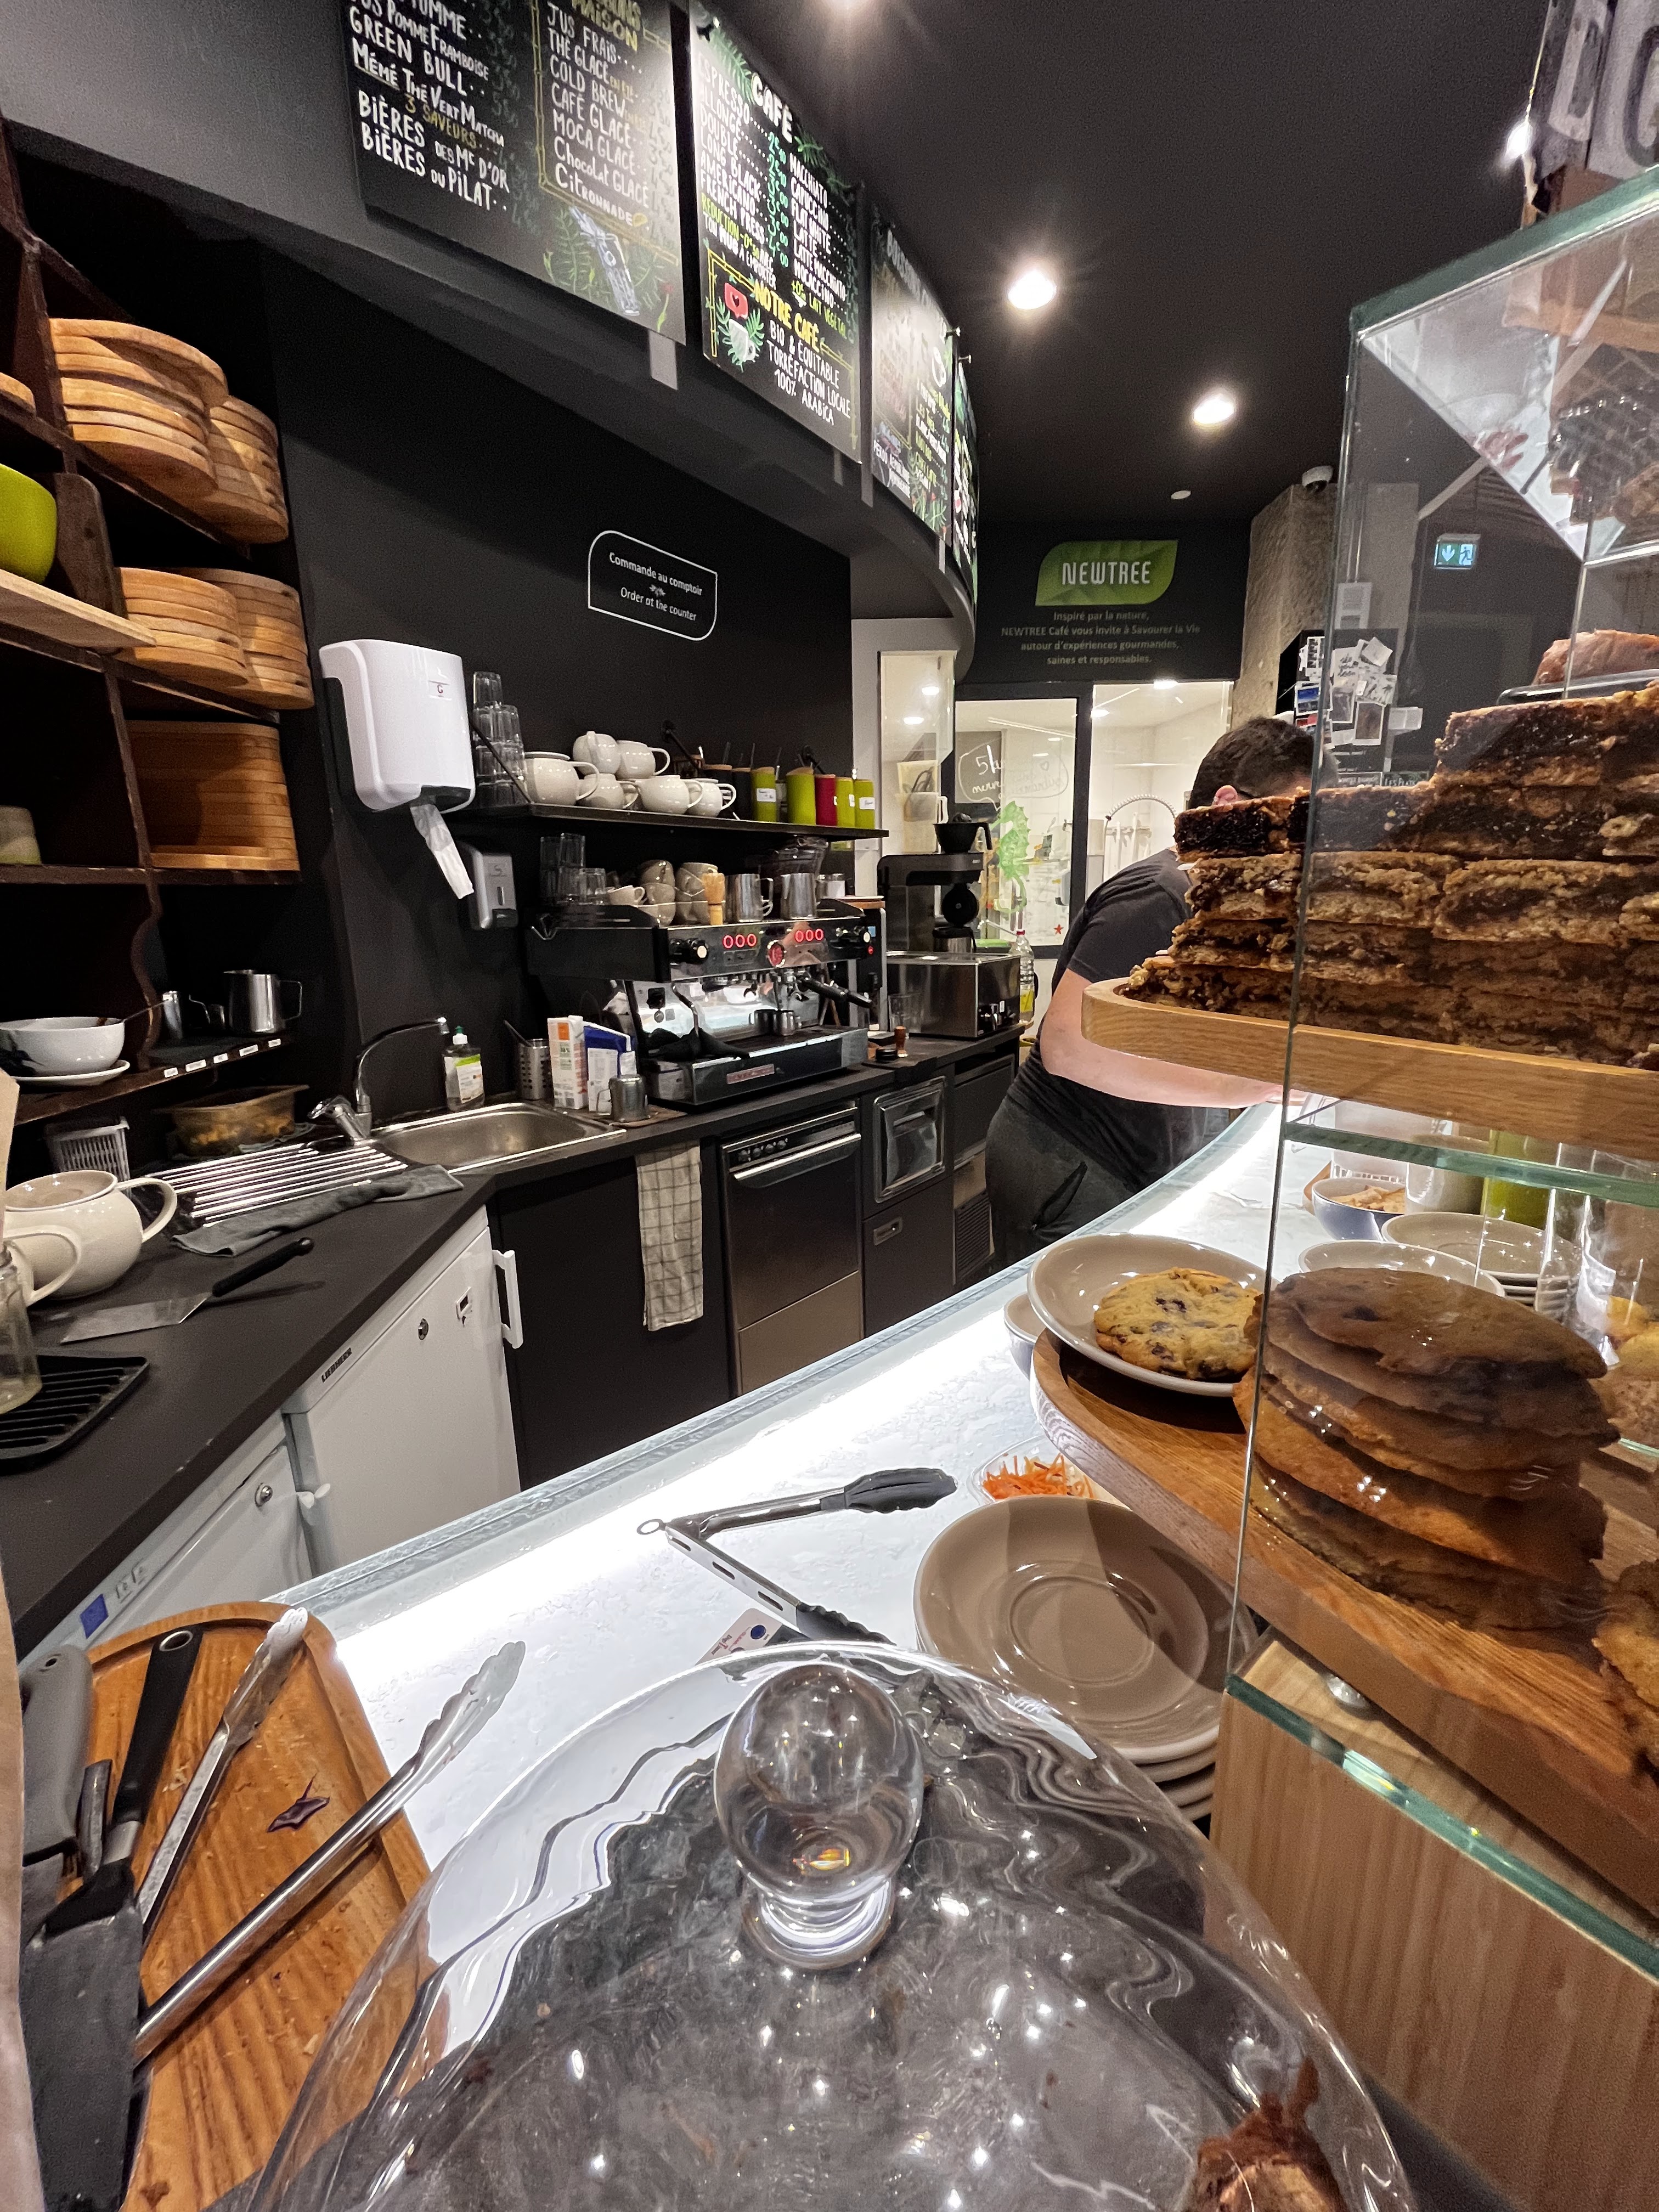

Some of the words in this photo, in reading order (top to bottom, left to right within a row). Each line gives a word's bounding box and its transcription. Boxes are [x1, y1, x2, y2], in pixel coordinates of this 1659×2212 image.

[548, 1, 575, 38] JUS
[349, 5, 412, 63] GREEN
[424, 50, 467, 96] BULL
[431, 85, 460, 120] VERT
[550, 54, 586, 93] COLD
[592, 80, 625, 117] BREW
[553, 109, 594, 151] MOCA
[431, 169, 445, 188] DU
[435, 140, 455, 164] DES
[479, 157, 510, 193] D'OR
[701, 126, 726, 166] LONG
[731, 156, 761, 202] BLACK
[701, 169, 737, 219] FRENCH
[741, 207, 765, 245] PRESS
[793, 219, 818, 258] LATTE
[755, 279, 792, 329] NOTRE
[789, 335, 796, 356] &
[774, 368, 797, 396] 100%
[827, 386, 851, 419] LOCALE
[610, 552, 657, 579] Commande
[658, 573, 668, 584] au
[669, 577, 703, 596] comptoir
[1062, 561, 1151, 585] NEWTREE
[620, 587, 644, 603] Order
[646, 597, 654, 607] at
[656, 600, 667, 612] the
[669, 605, 697, 621] counter
[1053, 611, 1085, 622] Inspiré
[1088, 612, 1103, 622] par
[1105, 610, 1114, 620] la
[1001, 627, 1047, 636] NEWTREE
[1049, 625, 1069, 635] Café
[1071, 627, 1093, 635] vous
[1132, 624, 1172, 634] Savourer
[1175, 624, 1183, 633] la
[1186, 623, 1200, 633] Vie
[1021, 641, 1052, 650] autour
[1047, 656, 1076, 664] saines
